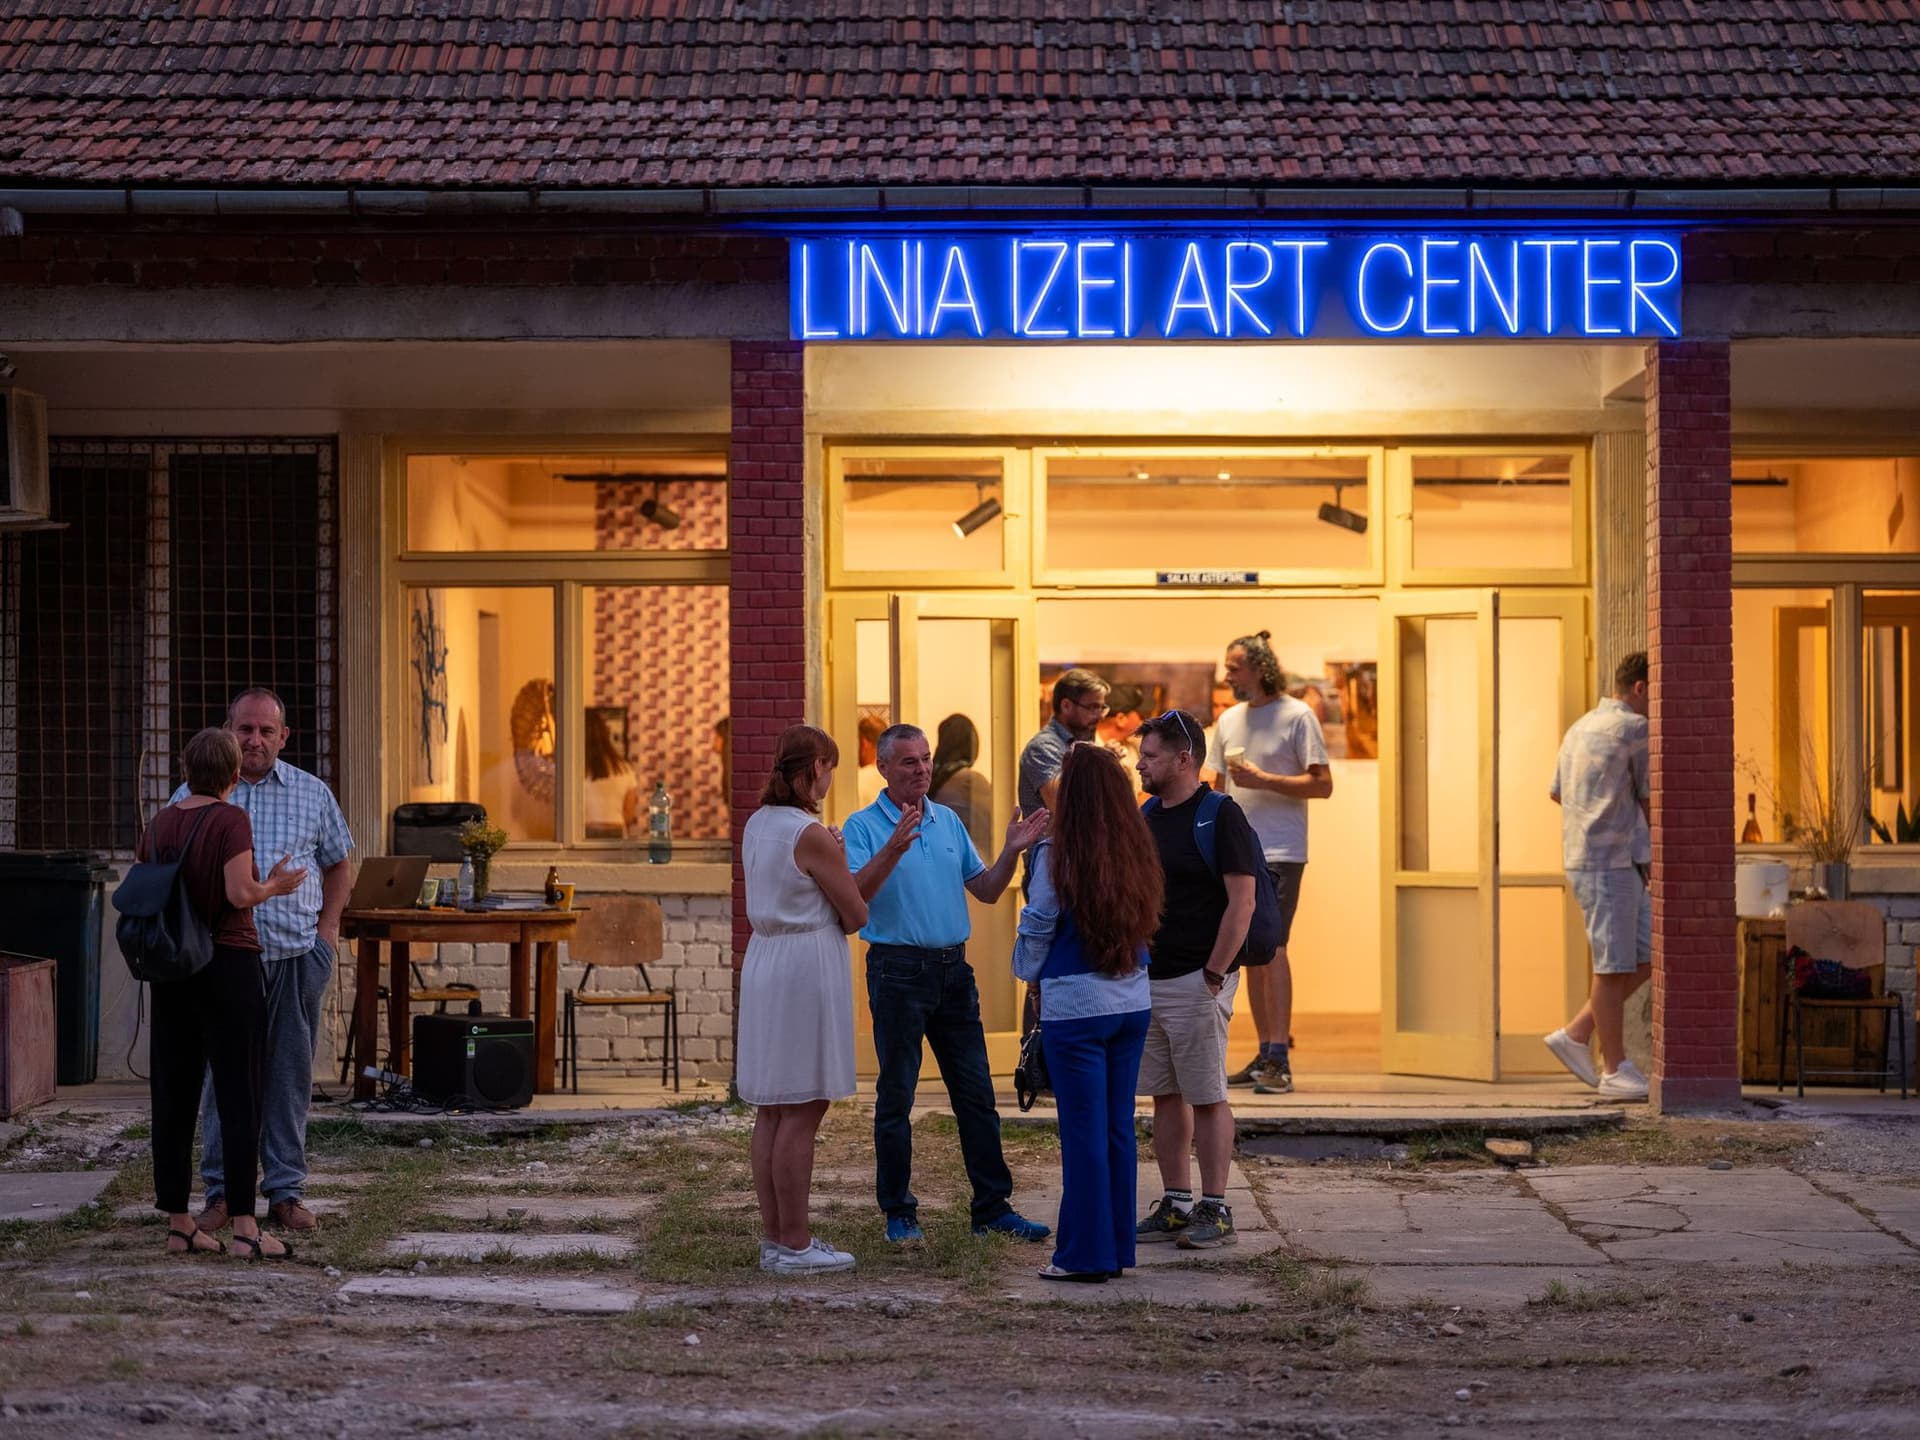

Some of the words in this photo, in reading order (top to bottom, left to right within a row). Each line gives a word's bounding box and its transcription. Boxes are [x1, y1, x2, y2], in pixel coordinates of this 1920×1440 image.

[801, 239, 983, 337] LINIA
[1011, 239, 1130, 337] IZEI
[1164, 240, 1329, 337] ART
[1357, 238, 1680, 336] CENTER
